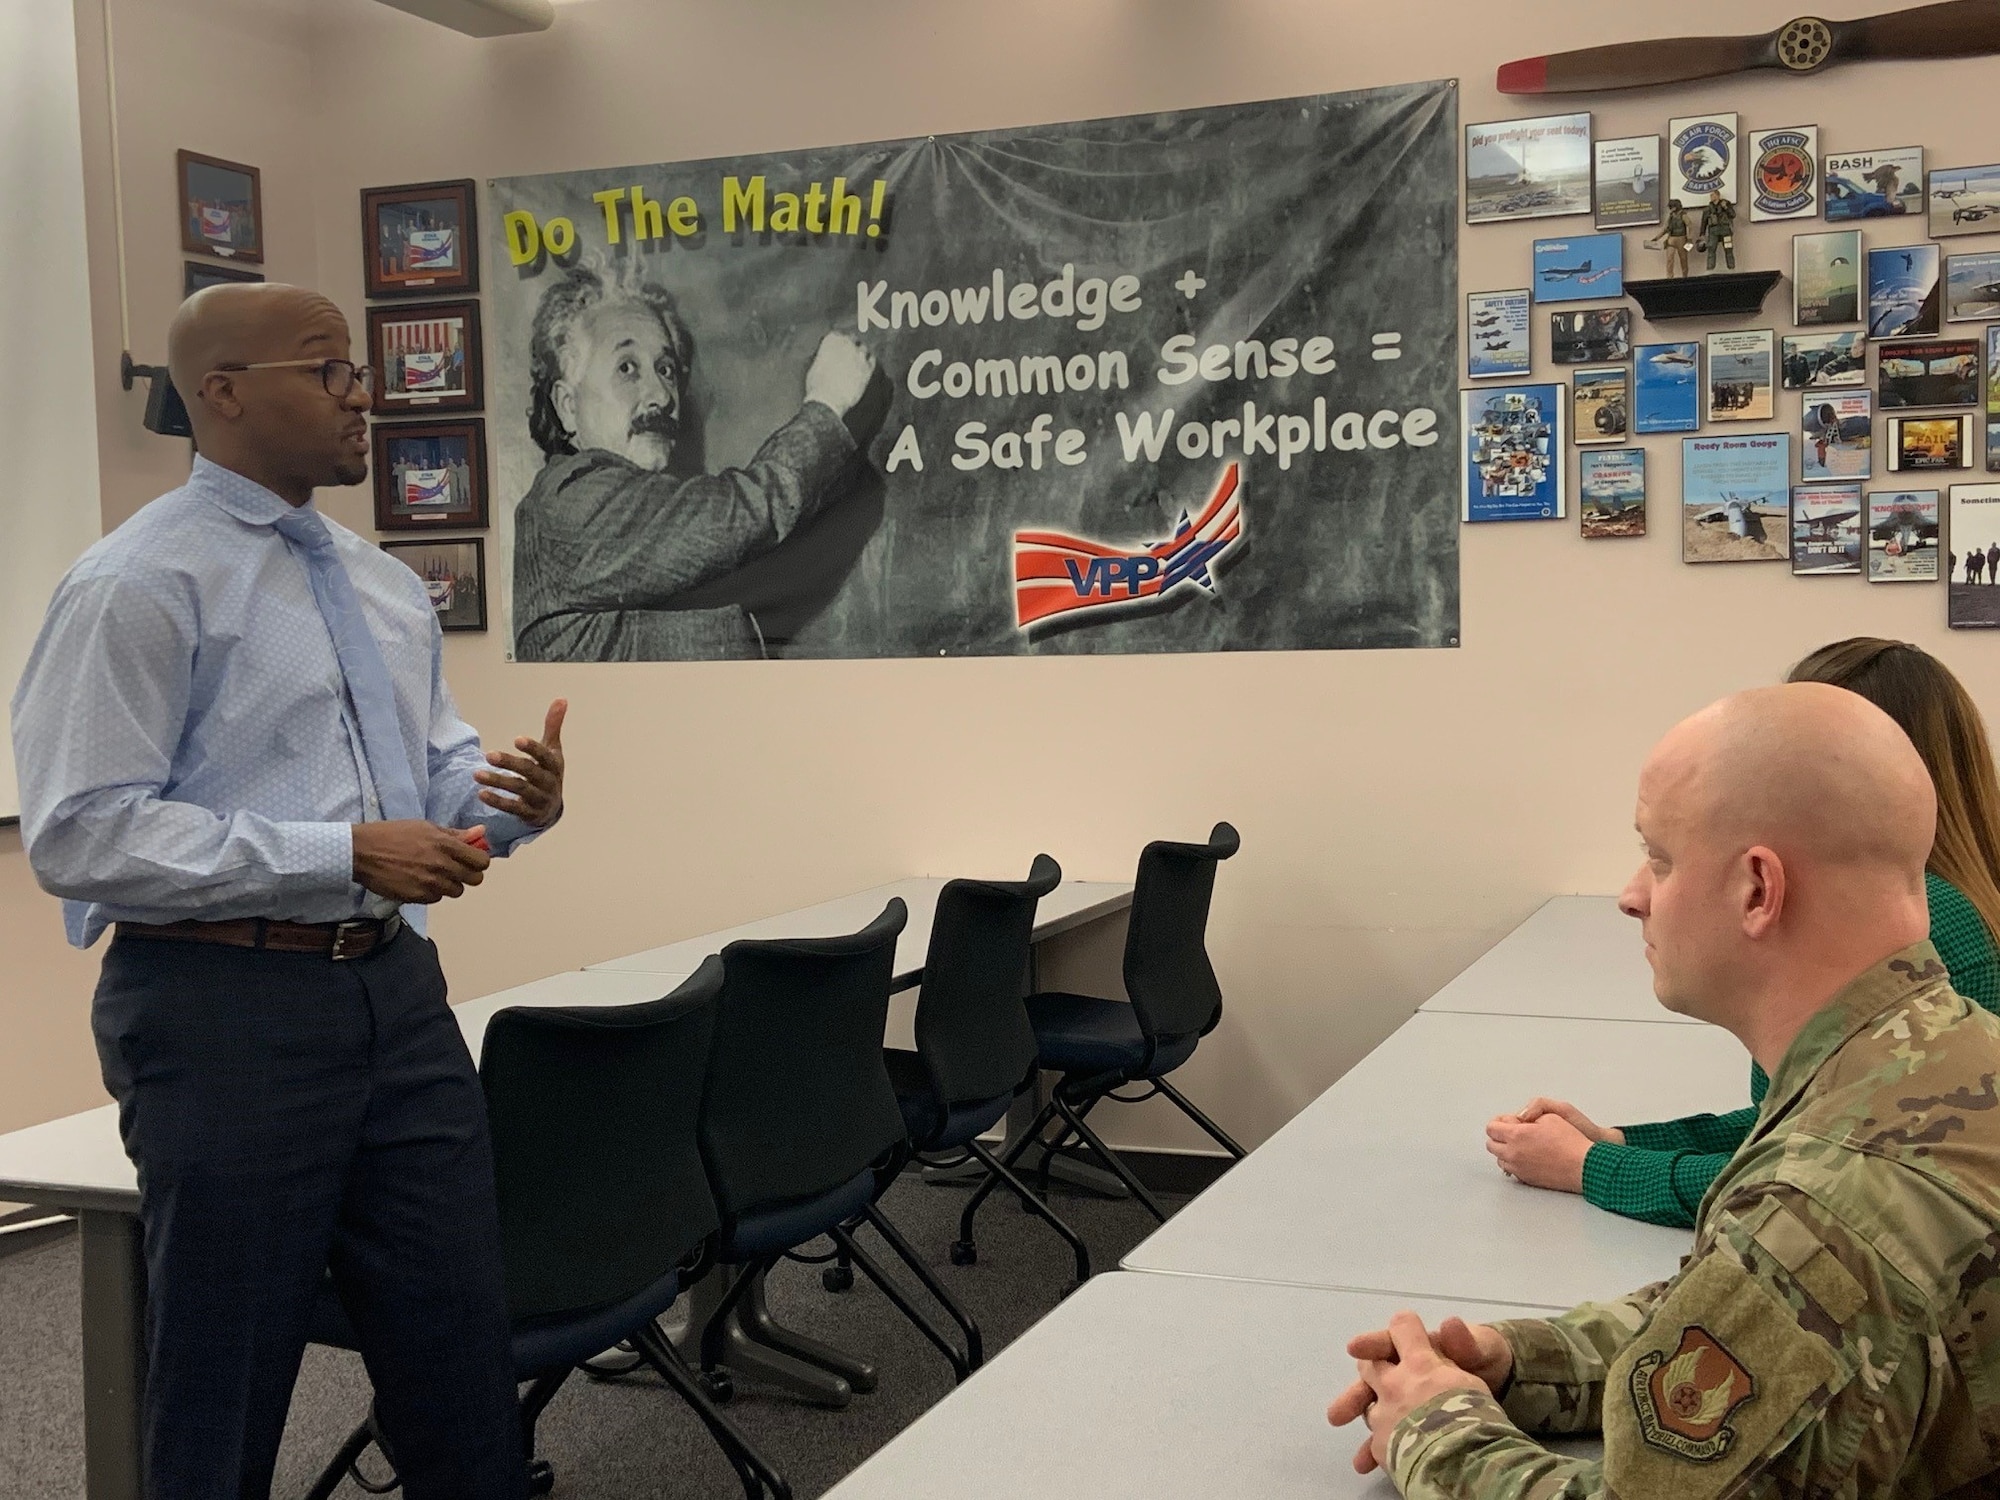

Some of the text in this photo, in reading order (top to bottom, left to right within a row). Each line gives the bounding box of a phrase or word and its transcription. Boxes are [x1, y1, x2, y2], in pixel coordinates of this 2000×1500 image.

[1471, 134, 1484, 148] Did
[1677, 125, 1730, 145] US AIR FORCE
[1766, 136, 1800, 149] HQ AFSC
[1829, 156, 1873, 170] BASH
[1687, 179, 1720, 191] SAFETY
[1761, 196, 1806, 208] Aviation Safety
[503, 175, 887, 267] Do The Math!
[856, 262, 1207, 332] Knowledge +
[1484, 298, 1527, 308] SAFETY CULTURE
[906, 331, 1402, 399] Common Sense =
[885, 396, 1440, 474] A Safe Workplace
[1916, 434, 1946, 444] FAIL
[1694, 442, 1720, 451] Ready
[1723, 441, 1747, 449] Room
[1598, 454, 1625, 462] FLYING
[1592, 470, 1632, 479] CRASHING
[1807, 545, 1845, 554] DON'T DO IT
[1064, 556, 1159, 597] VPP
[1635, 1369, 1648, 1386] AIR
[1636, 1387, 1652, 1415] FORCE
